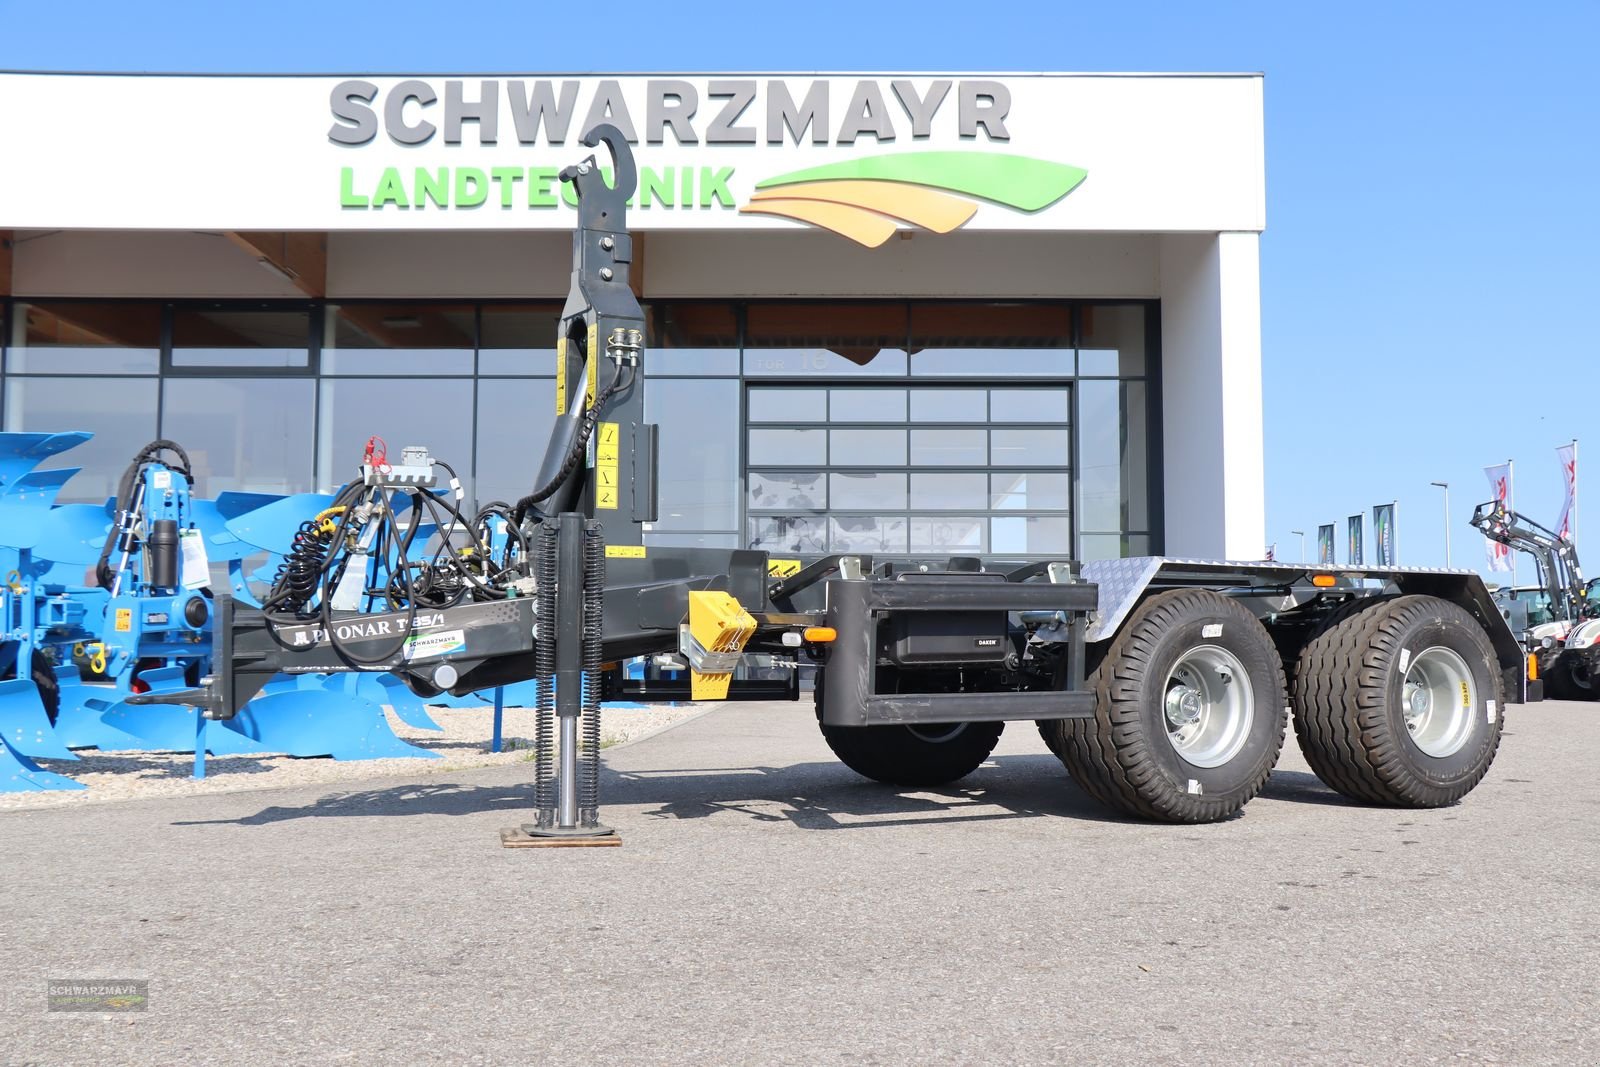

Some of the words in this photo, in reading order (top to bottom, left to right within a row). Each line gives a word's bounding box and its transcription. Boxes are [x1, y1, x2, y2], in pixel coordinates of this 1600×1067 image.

[328, 79, 1012, 145] SCHWARZMAYR
[340, 166, 736, 209] LANDTENIK
[757, 359, 785, 370] TOR
[799, 350, 829, 371] 16
